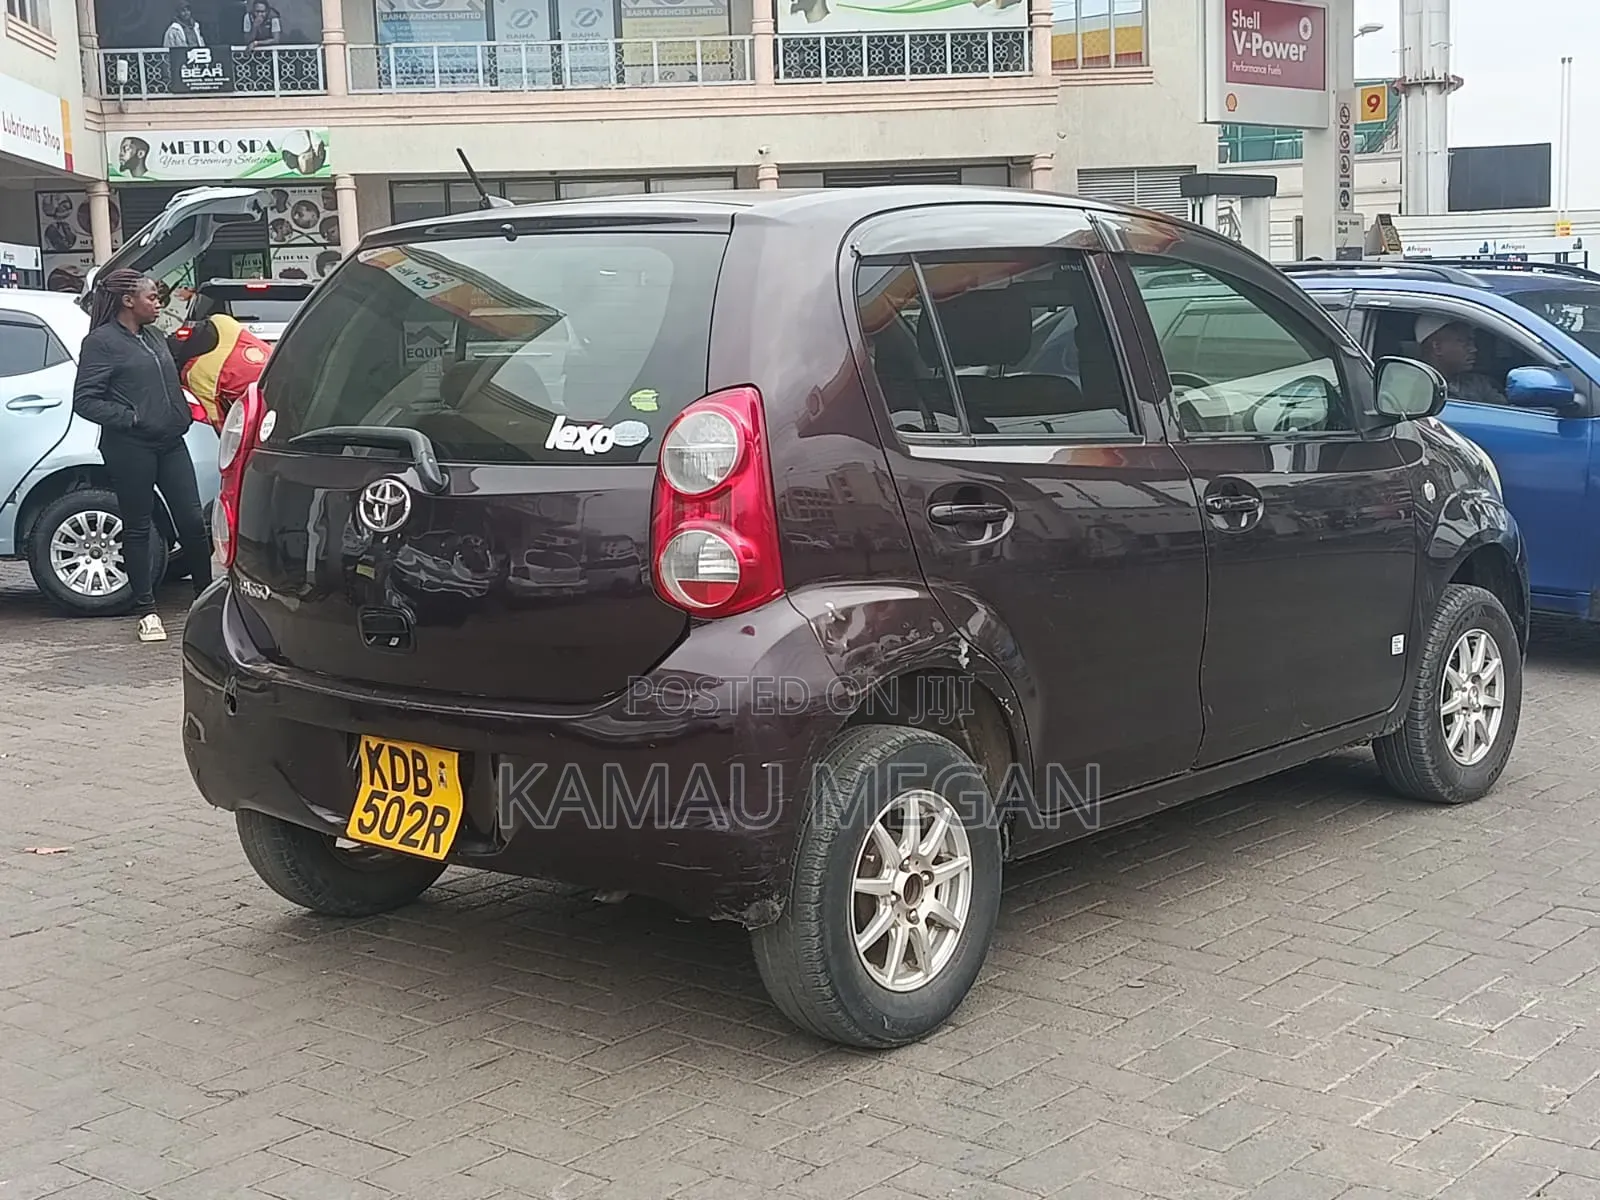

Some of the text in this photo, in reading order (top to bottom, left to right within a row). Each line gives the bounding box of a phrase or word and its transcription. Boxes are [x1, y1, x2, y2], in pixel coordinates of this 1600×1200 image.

[449, 11, 481, 19] LIMITED
[692, 7, 723, 15] LIMITED
[1232, 9, 1260, 30] Shell
[1232, 30, 1307, 62] V-Power
[181, 68, 223, 78] BEAR
[1232, 61, 1267, 75] Performance
[1367, 94, 1381, 113] 9
[2, 110, 61, 155] Lubricants Shop
[159, 138, 277, 155] METRO SPA
[406, 346, 446, 359] EQUIT
[545, 415, 616, 455] lexo
[364, 740, 433, 798] KDB
[357, 789, 451, 854] 502R
